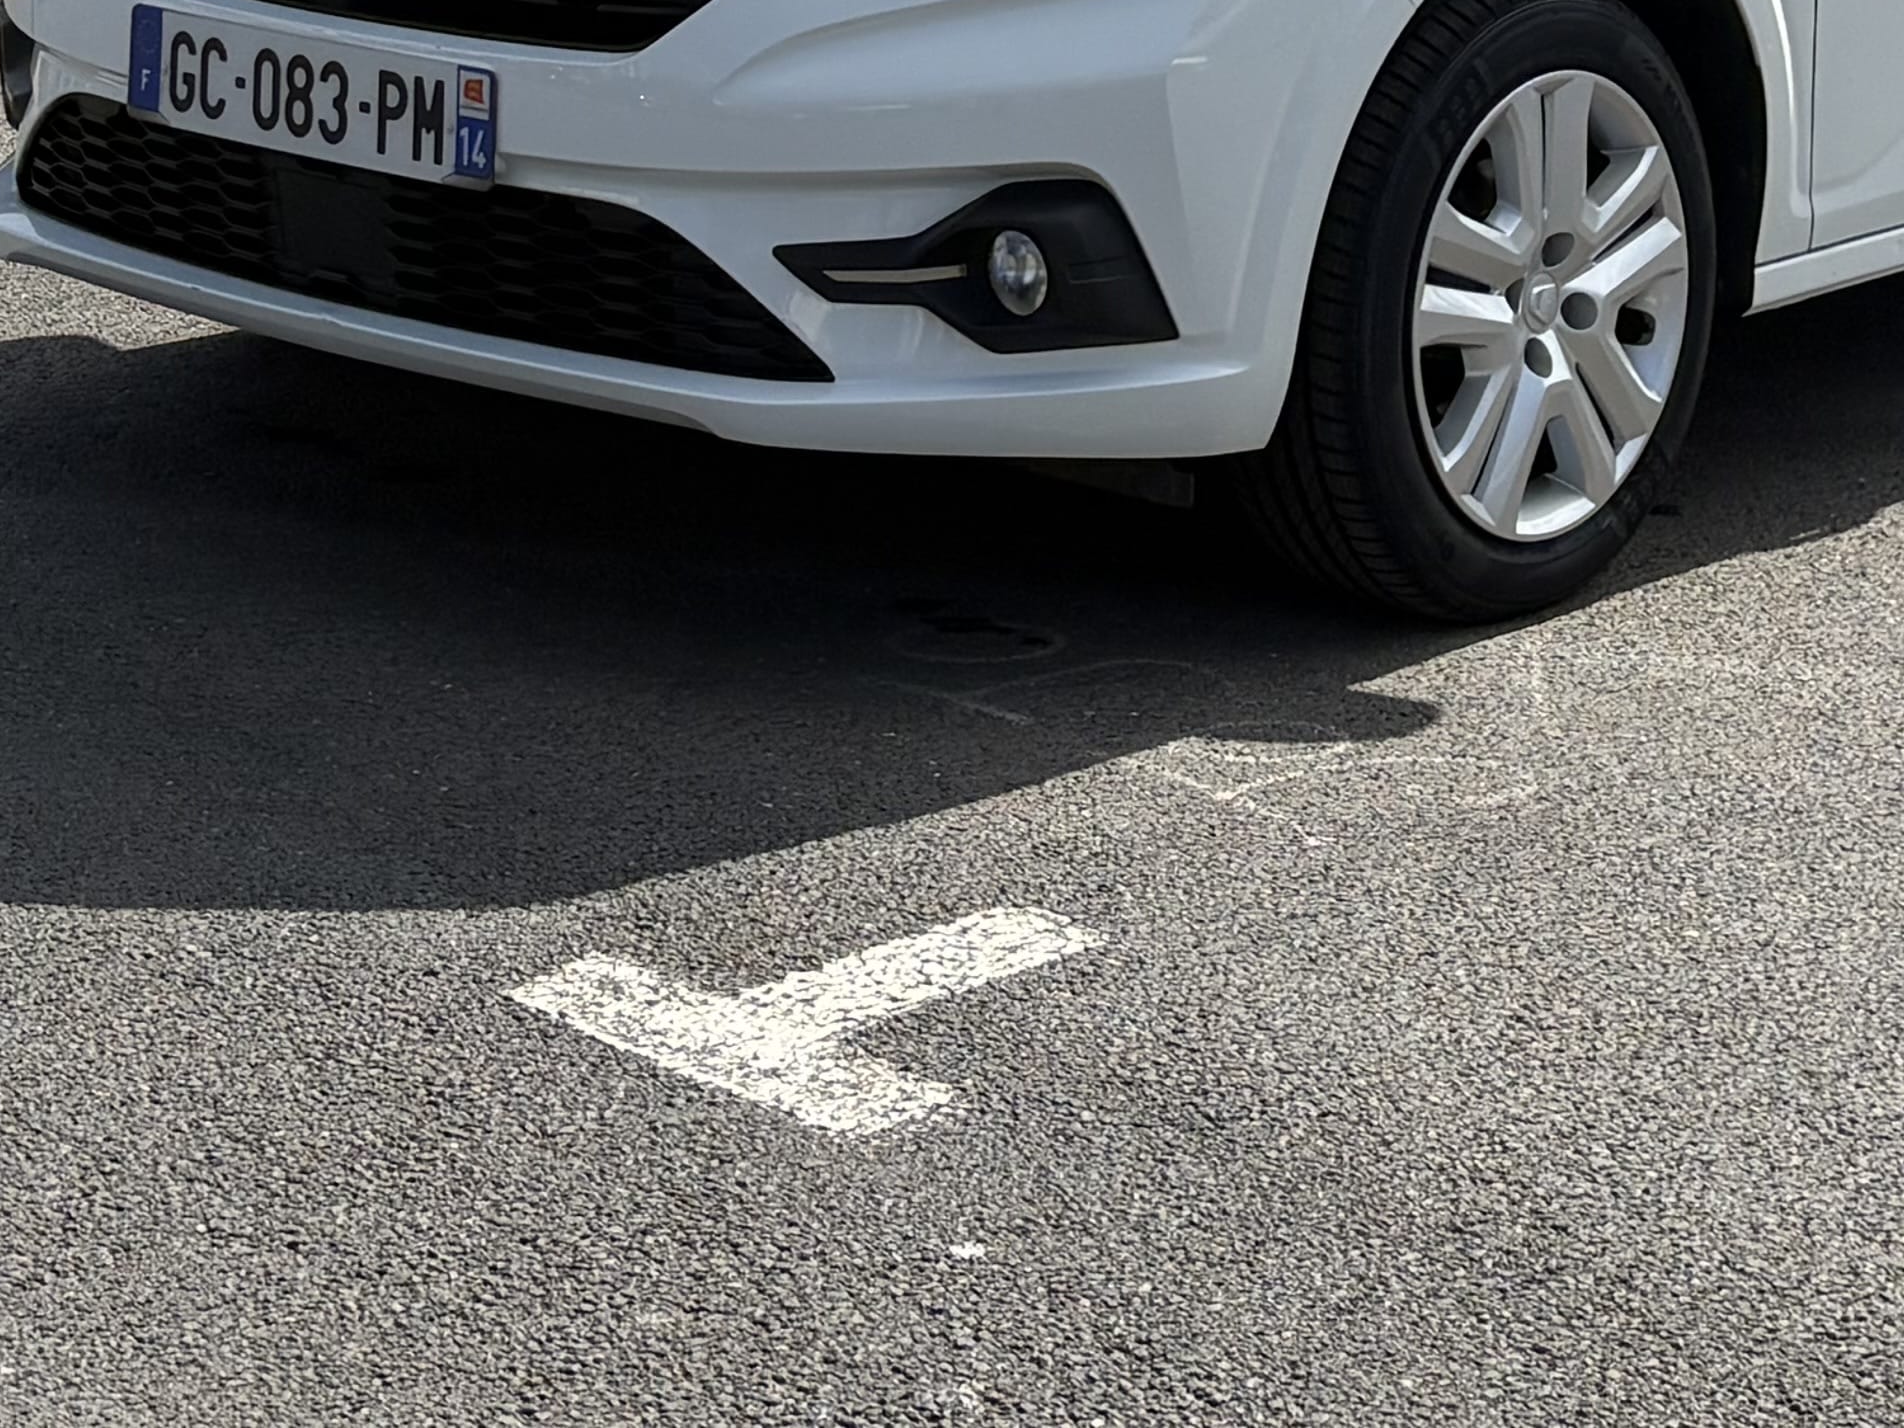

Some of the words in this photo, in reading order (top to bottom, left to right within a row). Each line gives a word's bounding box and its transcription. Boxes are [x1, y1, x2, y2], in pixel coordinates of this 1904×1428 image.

[140, 68, 152, 91] F
[169, 30, 445, 166] GC-083-PM
[459, 125, 487, 170] 14
